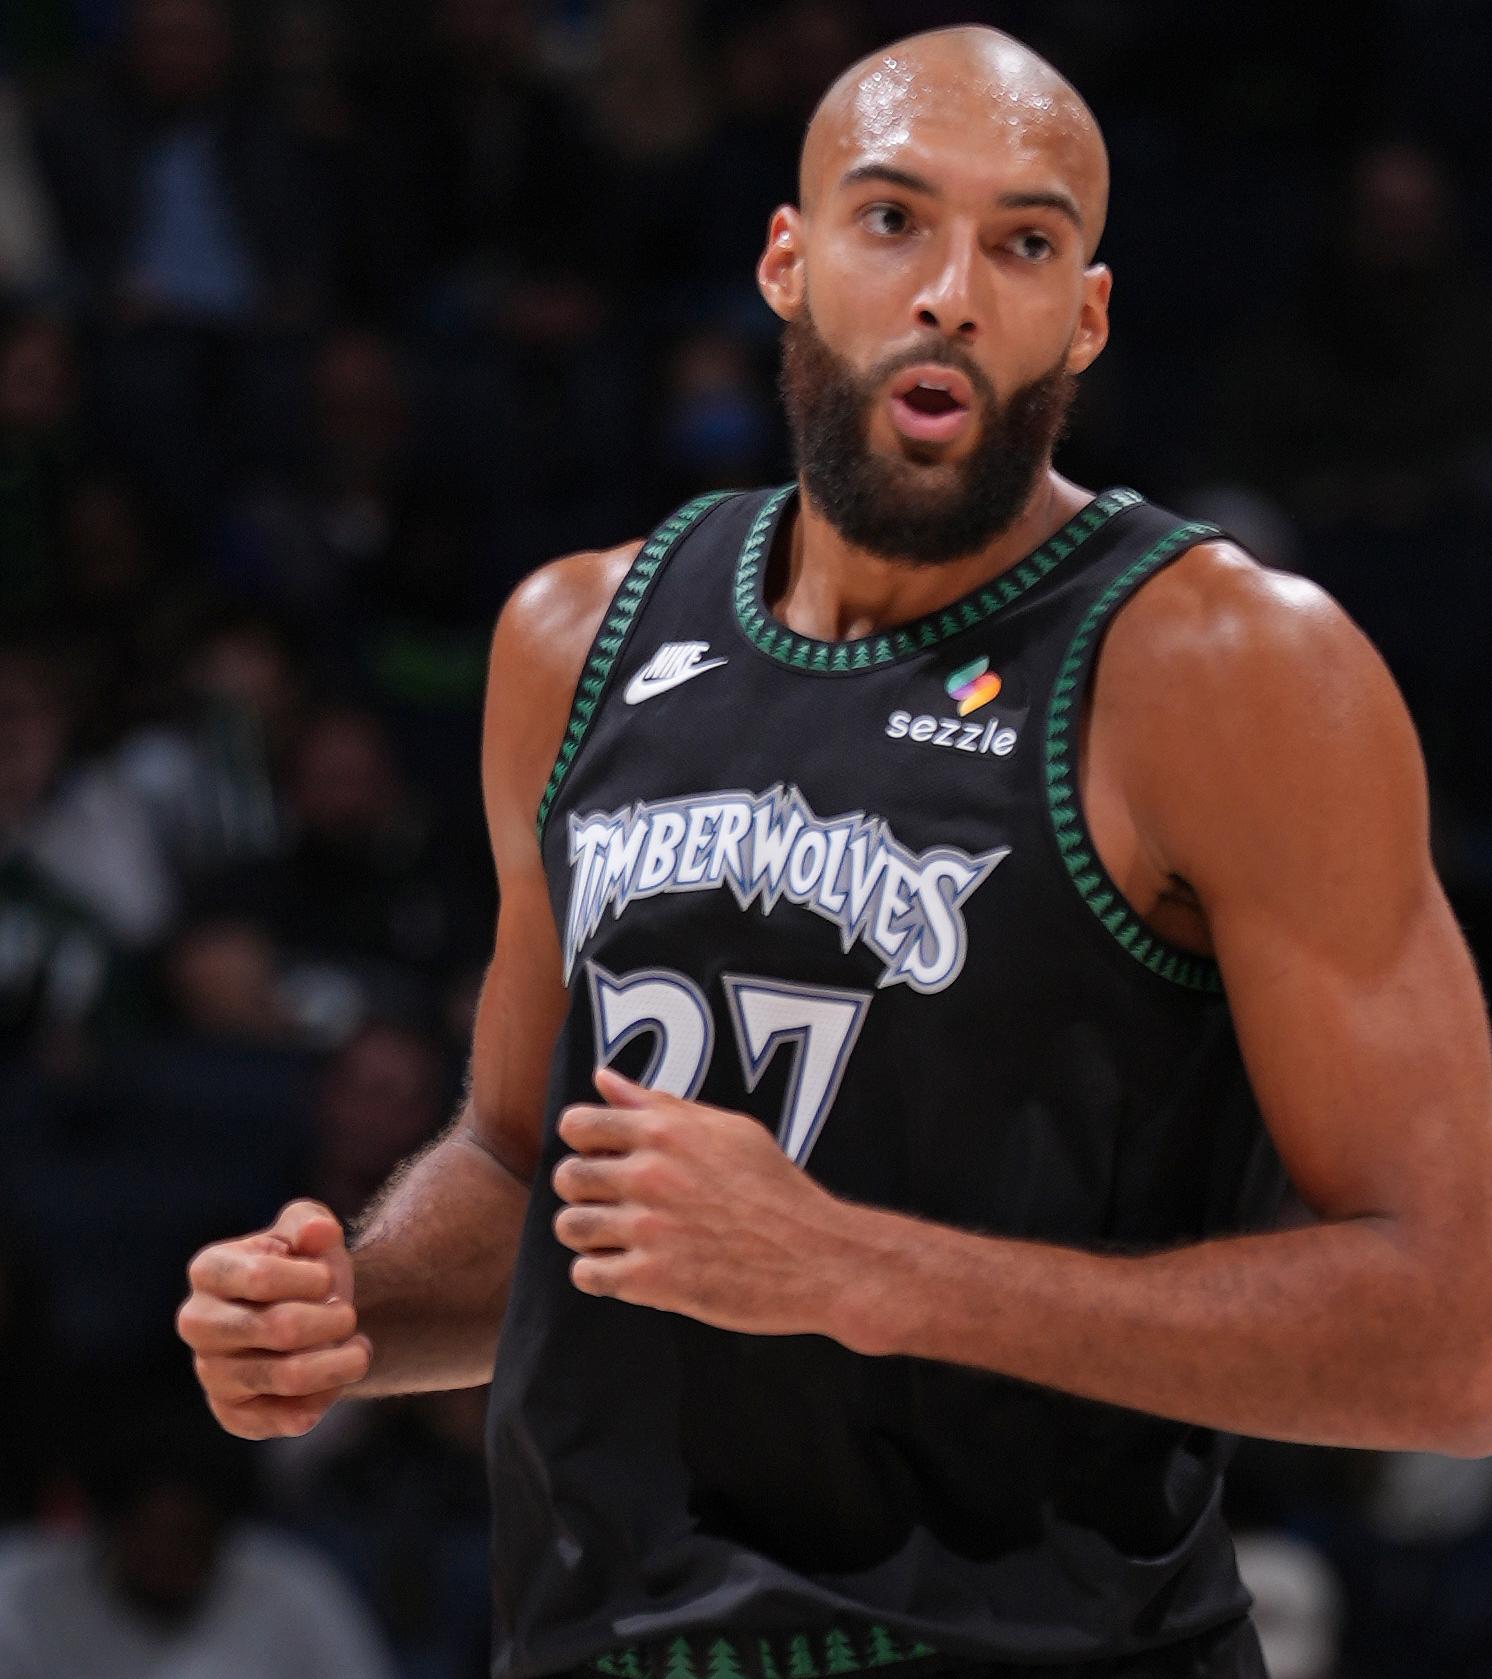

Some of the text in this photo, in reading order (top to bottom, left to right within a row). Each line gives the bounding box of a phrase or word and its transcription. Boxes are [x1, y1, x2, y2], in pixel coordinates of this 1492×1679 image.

[645, 641, 711, 680] NIKE
[885, 709, 1018, 757] sezzle
[563, 781, 1012, 995] TIMBERWOLVES
